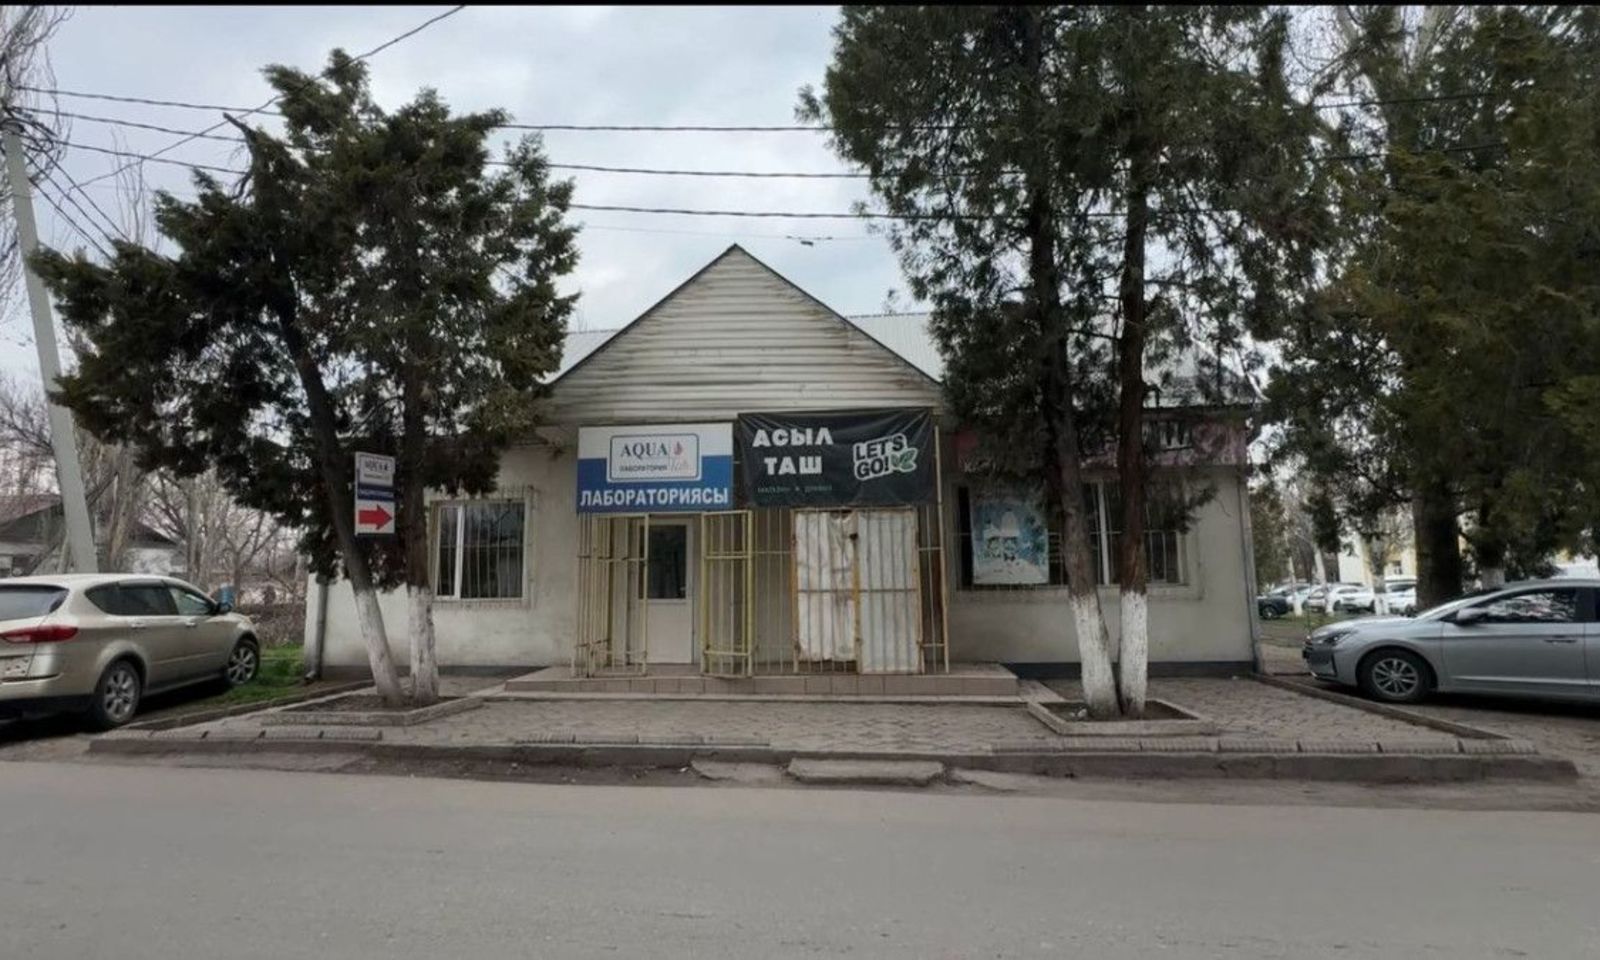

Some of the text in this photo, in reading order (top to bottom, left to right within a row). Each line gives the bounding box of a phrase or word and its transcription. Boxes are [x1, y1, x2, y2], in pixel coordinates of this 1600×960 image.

[752, 427, 834, 447] АСЫЛ
[620, 442, 668, 460] AQUA
[764, 456, 822, 475] ТАШ
[856, 456, 890, 478] GO!
[580, 487, 729, 507] ЛАБОРАТОРИЯСЫ
